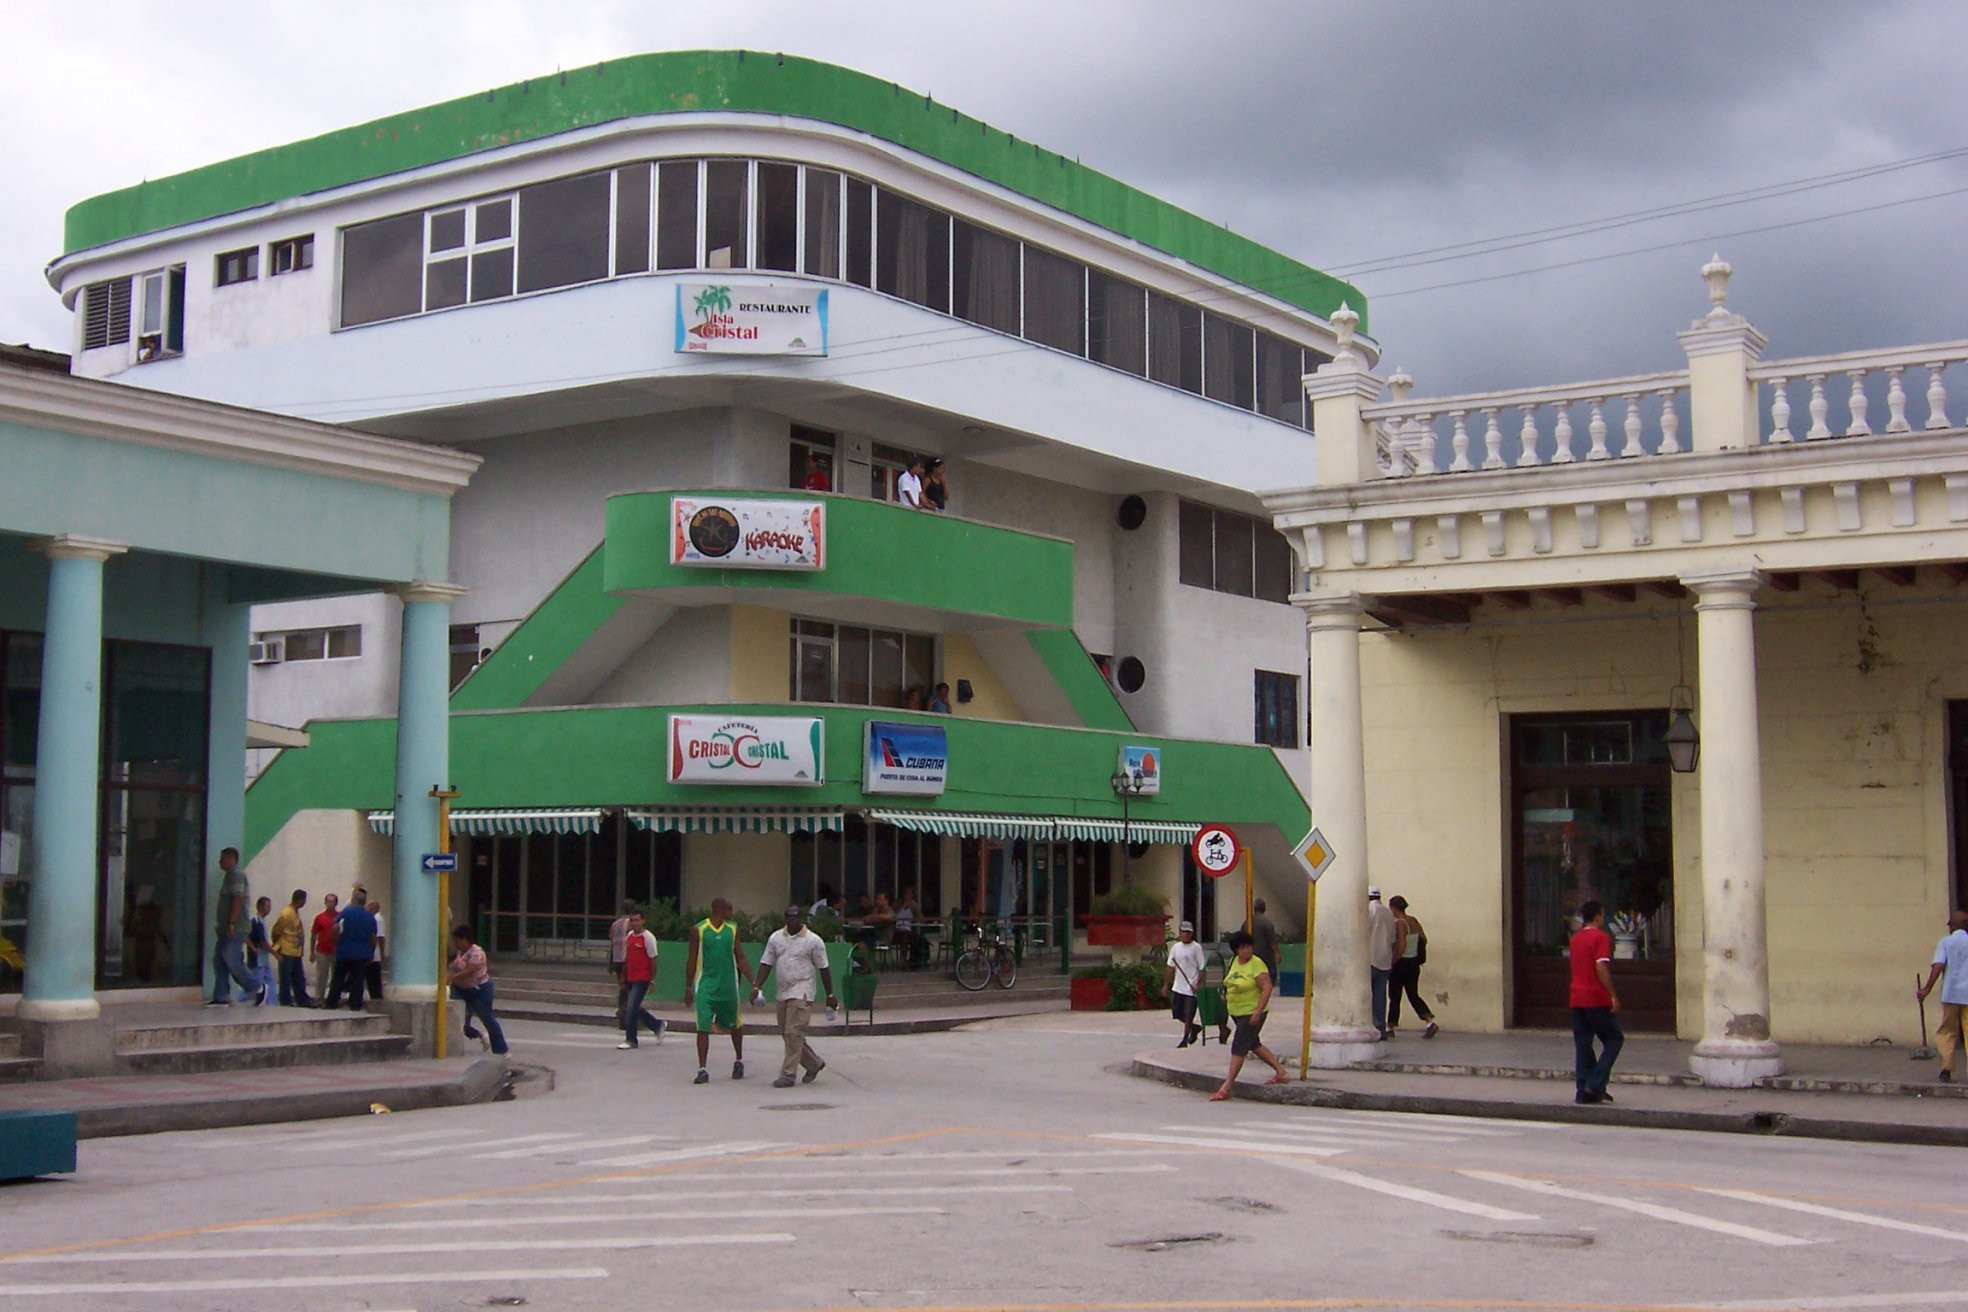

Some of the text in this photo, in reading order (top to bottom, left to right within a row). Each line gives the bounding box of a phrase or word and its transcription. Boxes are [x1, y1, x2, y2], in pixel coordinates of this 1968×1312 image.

[739, 304, 811, 314] RESTAURANTE
[702, 325, 759, 340] Cristal
[745, 531, 804, 553] KARAOKE
[689, 740, 731, 759] CRISTAL
[748, 741, 789, 760] CRISTAL
[906, 757, 944, 770] CUBANA
